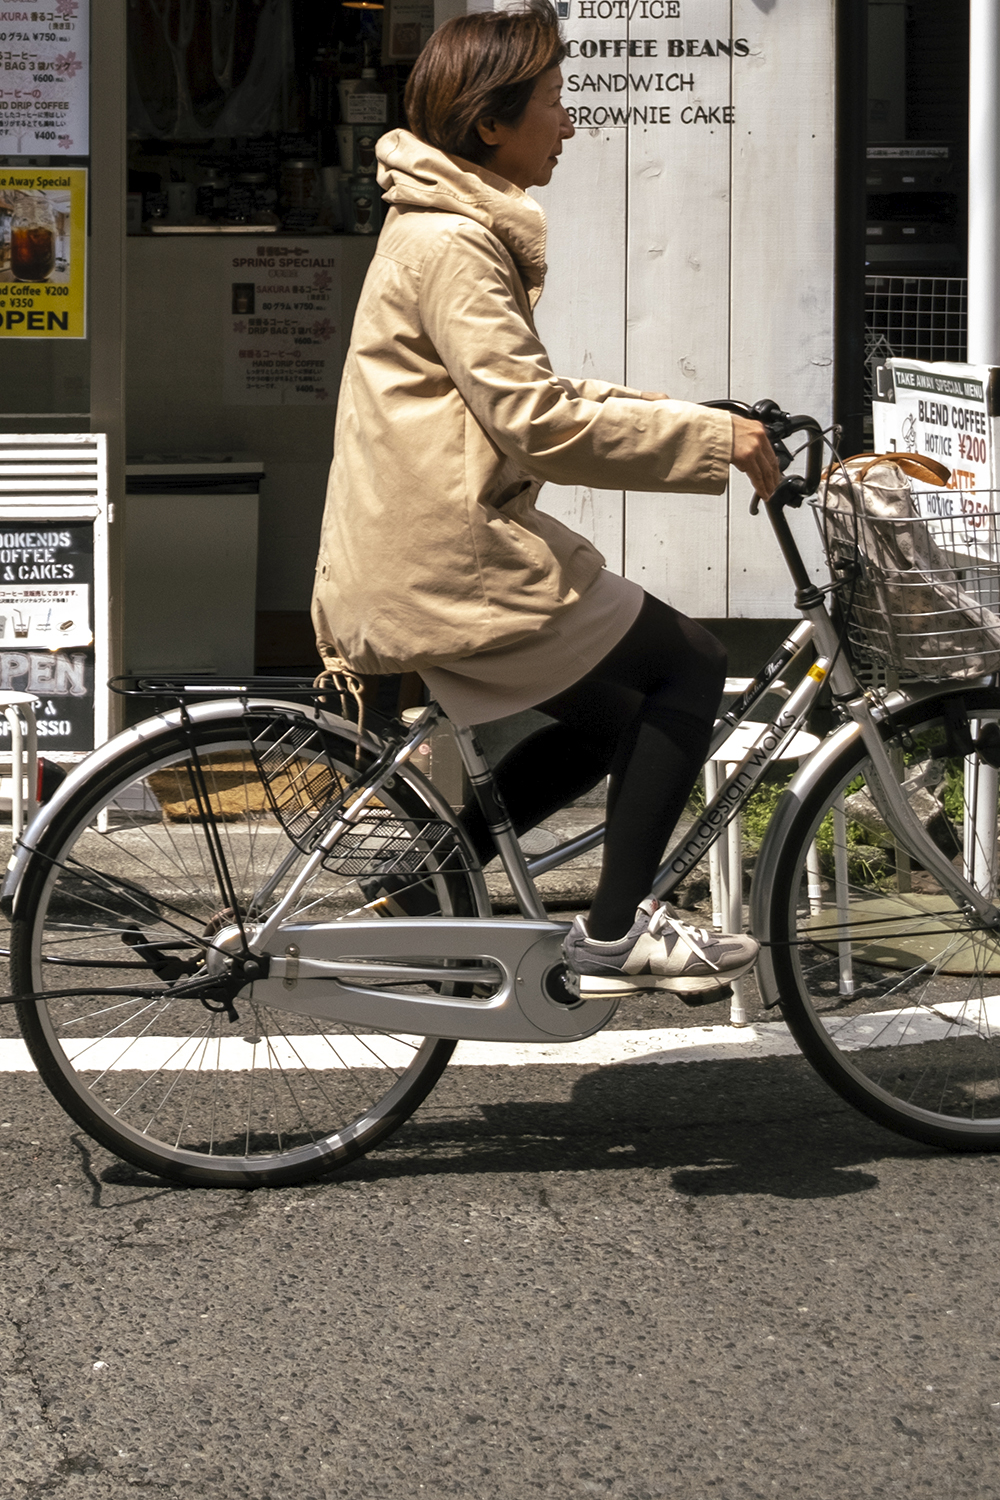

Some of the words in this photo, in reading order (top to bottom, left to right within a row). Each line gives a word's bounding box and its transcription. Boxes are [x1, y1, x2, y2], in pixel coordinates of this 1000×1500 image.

[30, 12, 78, 22] 香るコーヒー
[565, 40, 658, 58] COFFEE
[667, 38, 750, 58] BEANS
[4, 62, 26, 71] BAG
[567, 73, 695, 92] SANDWICH
[10, 101, 32, 110] DRIP
[34, 101, 70, 110] COFFEE
[567, 106, 671, 125] BROWNIE
[680, 106, 736, 125] CAKE
[8, 176, 35, 188] Away
[36, 176, 71, 188] Special
[232, 258, 275, 268] SPRING
[278, 258, 335, 268] SPECIAL!!
[10, 285, 41, 296] Coffee
[45, 286, 69, 296] ¥200
[256, 285, 290, 294] SAKURA
[9, 298, 34, 308] ¥350
[896, 371, 916, 387] TAKE
[916, 374, 936, 390] AWAY
[935, 378, 963, 395] SPECIAL
[963, 382, 983, 399] MENU
[918, 399, 949, 427] BLEND
[951, 406, 986, 435] COFFEE
[925, 432, 952, 457] HOT/ICE
[958, 433, 987, 464] ¥200
[3, 565, 14, 580] &
[18, 564, 74, 580] CAKES
[44, 700, 56, 715] &
[671, 771, 751, 874] a.n.design
[748, 710, 796, 767] works
